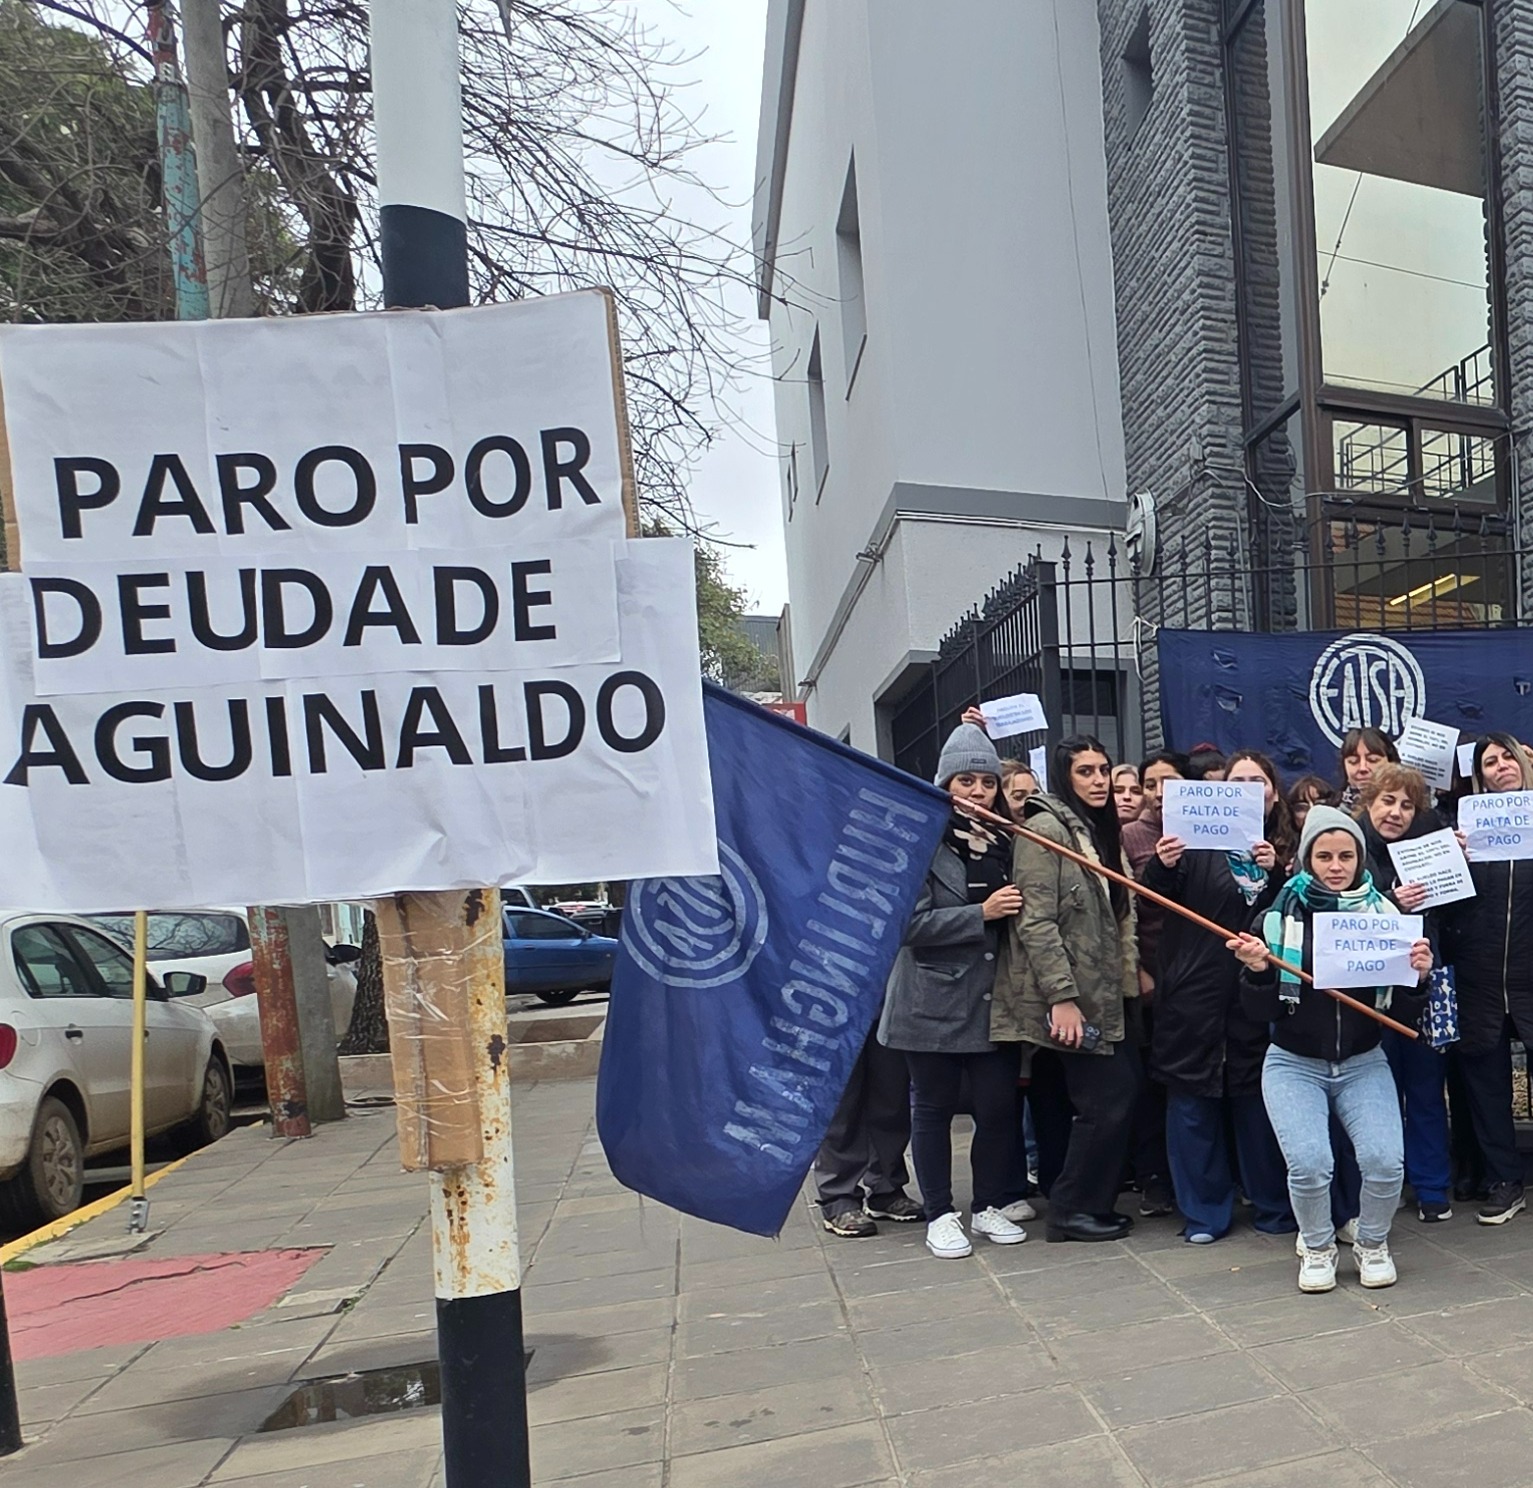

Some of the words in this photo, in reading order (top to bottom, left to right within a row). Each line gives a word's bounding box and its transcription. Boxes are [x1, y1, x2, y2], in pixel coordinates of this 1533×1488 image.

[53, 445, 377, 539] PARO
[398, 426, 602, 524] POR
[30, 565, 422, 660] DEUDA
[432, 559, 557, 646] DE
[3, 670, 666, 787] AGUINALDO
[1180, 786, 1213, 797] PARO
[1217, 787, 1242, 798] POR
[1473, 798, 1504, 810] PARO
[1506, 796, 1531, 806] POR
[1182, 806, 1220, 816] FALTA
[1224, 806, 1239, 817] DE
[1476, 816, 1511, 828] FALTA
[1515, 815, 1530, 826] DE
[1194, 824, 1229, 835] PAGO
[1488, 834, 1520, 846] PAGO
[1332, 919, 1368, 930] PARO
[1372, 919, 1399, 930] POR
[1334, 939, 1375, 951] FALTA
[1380, 939, 1397, 950] DE
[1347, 960, 1385, 972] PAGO
